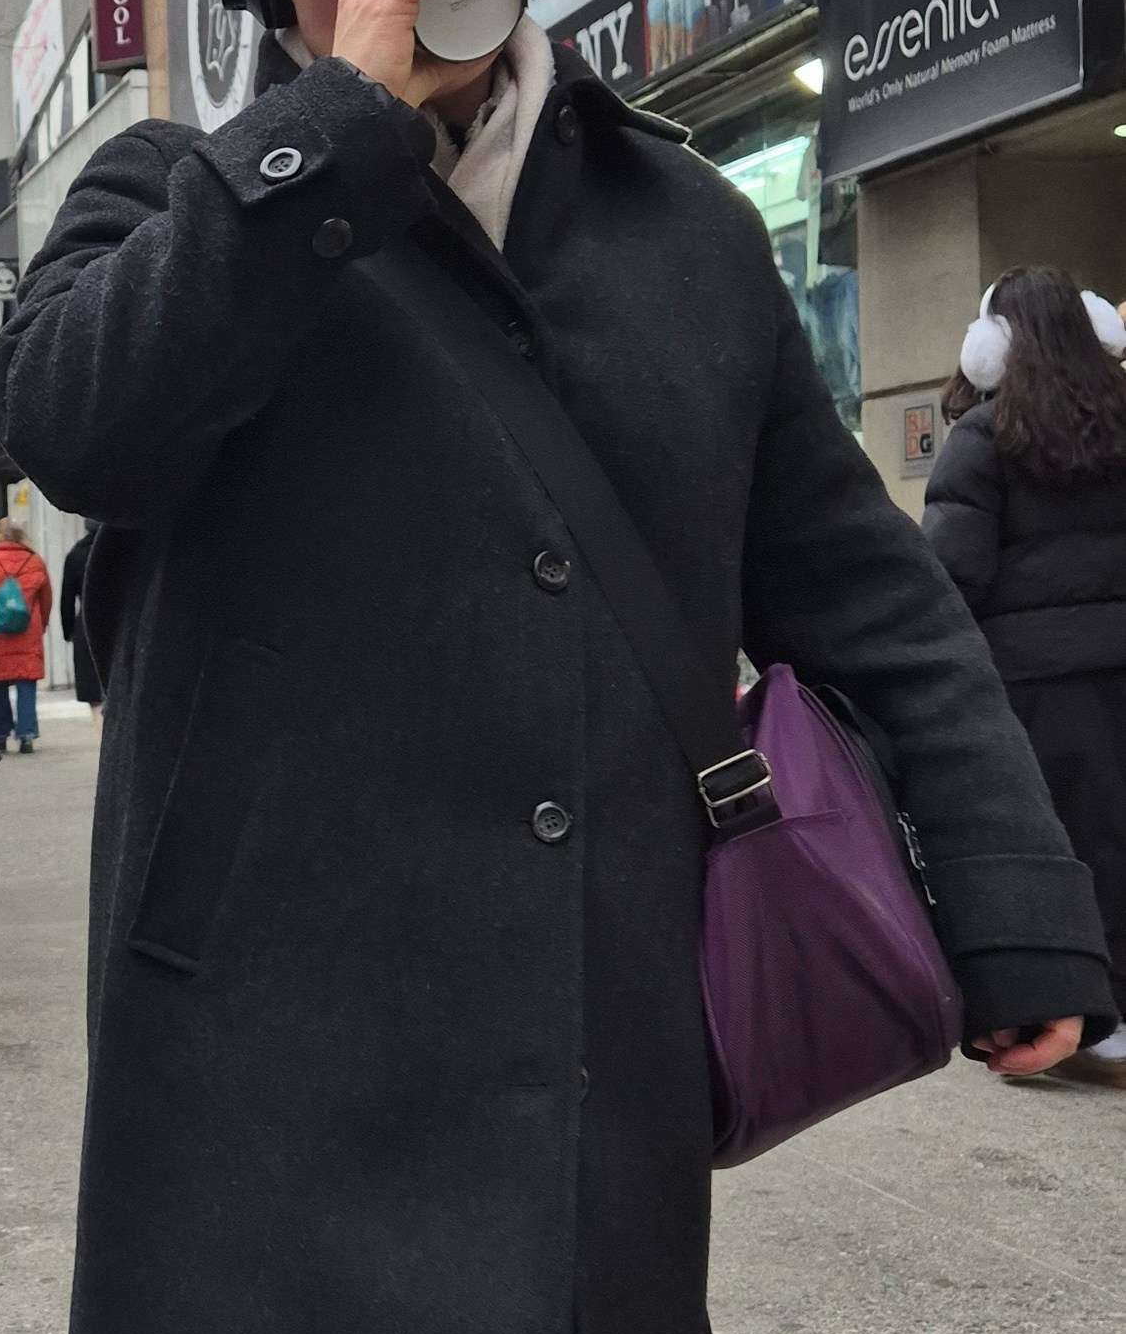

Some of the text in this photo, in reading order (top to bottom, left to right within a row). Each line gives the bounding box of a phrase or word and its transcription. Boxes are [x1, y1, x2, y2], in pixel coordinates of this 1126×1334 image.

[847, 14, 1057, 113] World's Only Natural Memory Foam Mattress
